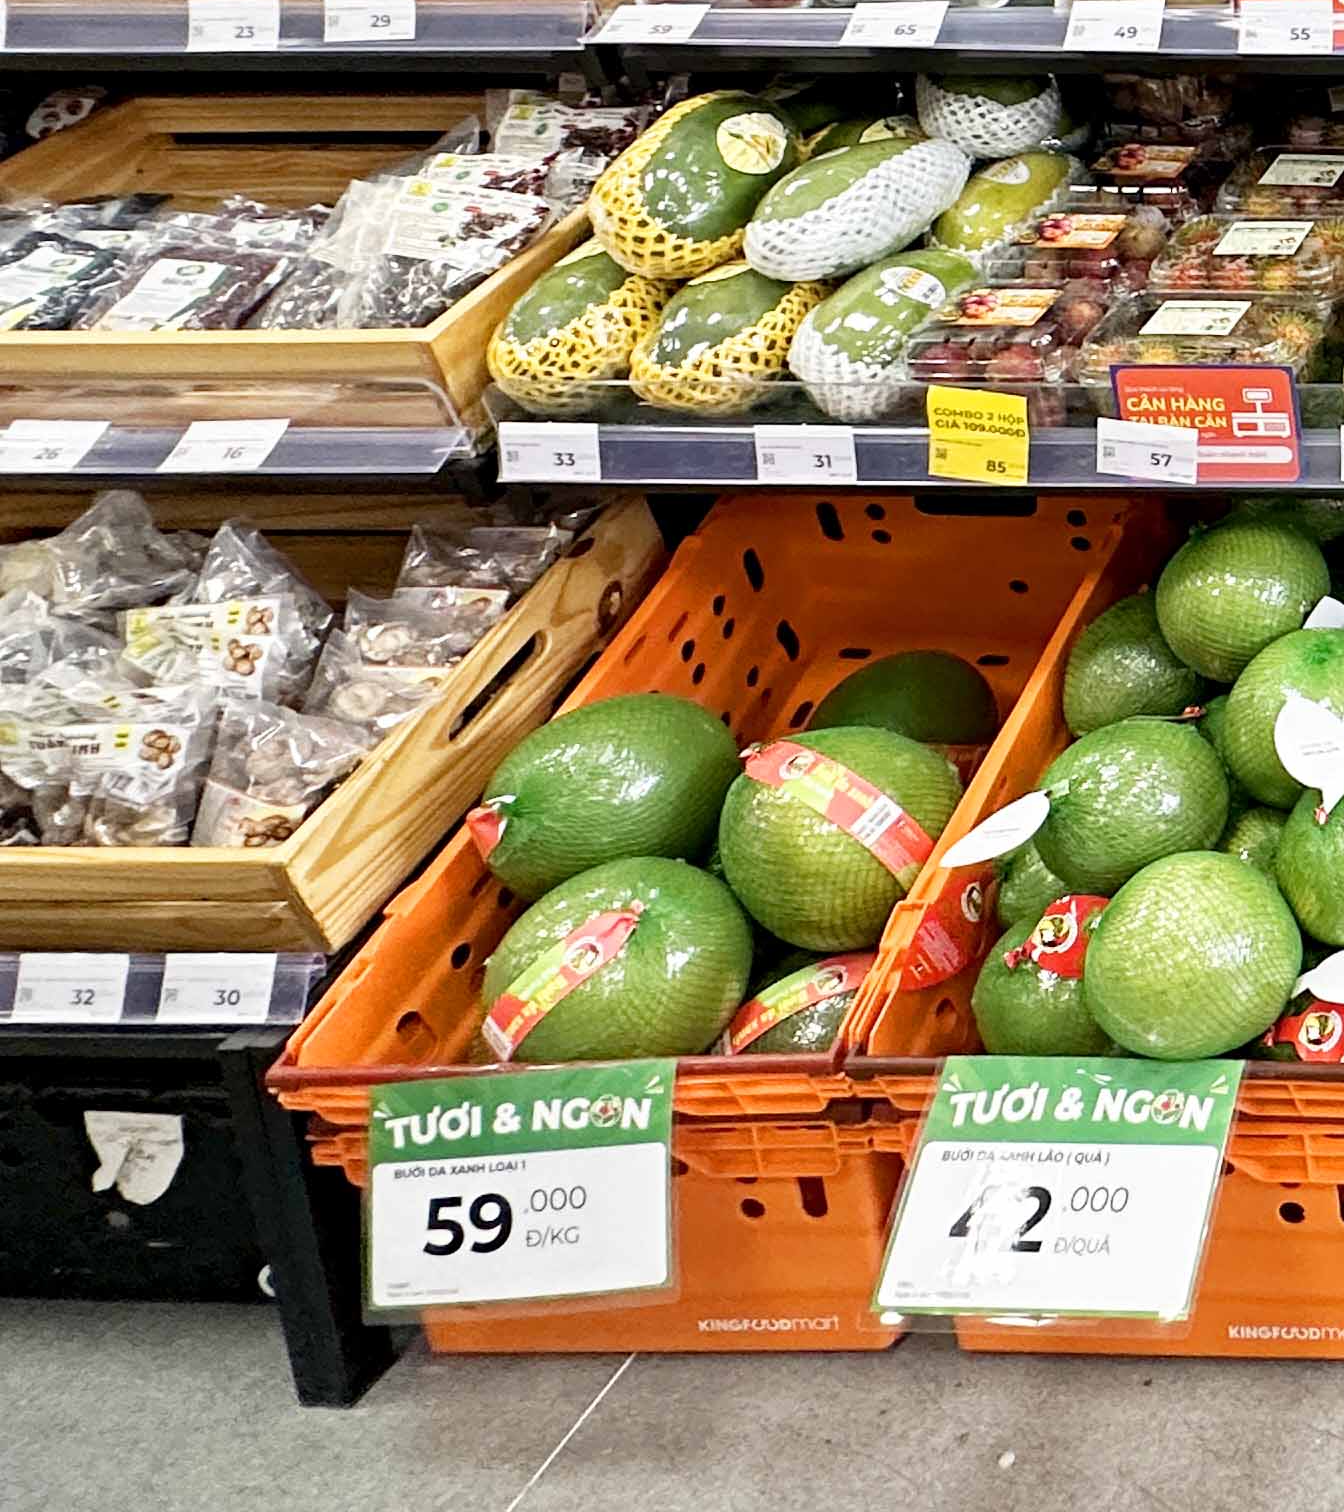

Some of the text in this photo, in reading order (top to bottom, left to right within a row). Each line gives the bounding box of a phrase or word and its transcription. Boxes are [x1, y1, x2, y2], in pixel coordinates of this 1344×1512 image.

[370, 15, 391, 28] 29
[234, 26, 255, 39] 23
[894, 24, 917, 35] 65
[1114, 26, 1137, 39] 49
[1290, 28, 1311, 40] 55
[1127, 393, 1226, 412] CÂN HÀNG
[934, 407, 984, 420] COMBO
[1195, 414, 1228, 428] CÂN
[553, 452, 576, 467] 33
[813, 454, 832, 469] 31
[986, 459, 1006, 474] 85
[1150, 452, 1173, 467] 57
[71, 989, 95, 1006] 32
[213, 989, 240, 1006] 30
[950, 1082, 1049, 1128] TƯƠI
[1054, 1084, 1084, 1121] &
[385, 1102, 481, 1149] TƯƠI
[494, 1102, 521, 1134] &
[450, 1162, 485, 1176] XANH
[423, 1185, 587, 1257] 59 .000
[526, 1226, 580, 1248] Đ/KG
[697, 1314, 840, 1333] KINGFOODmart
